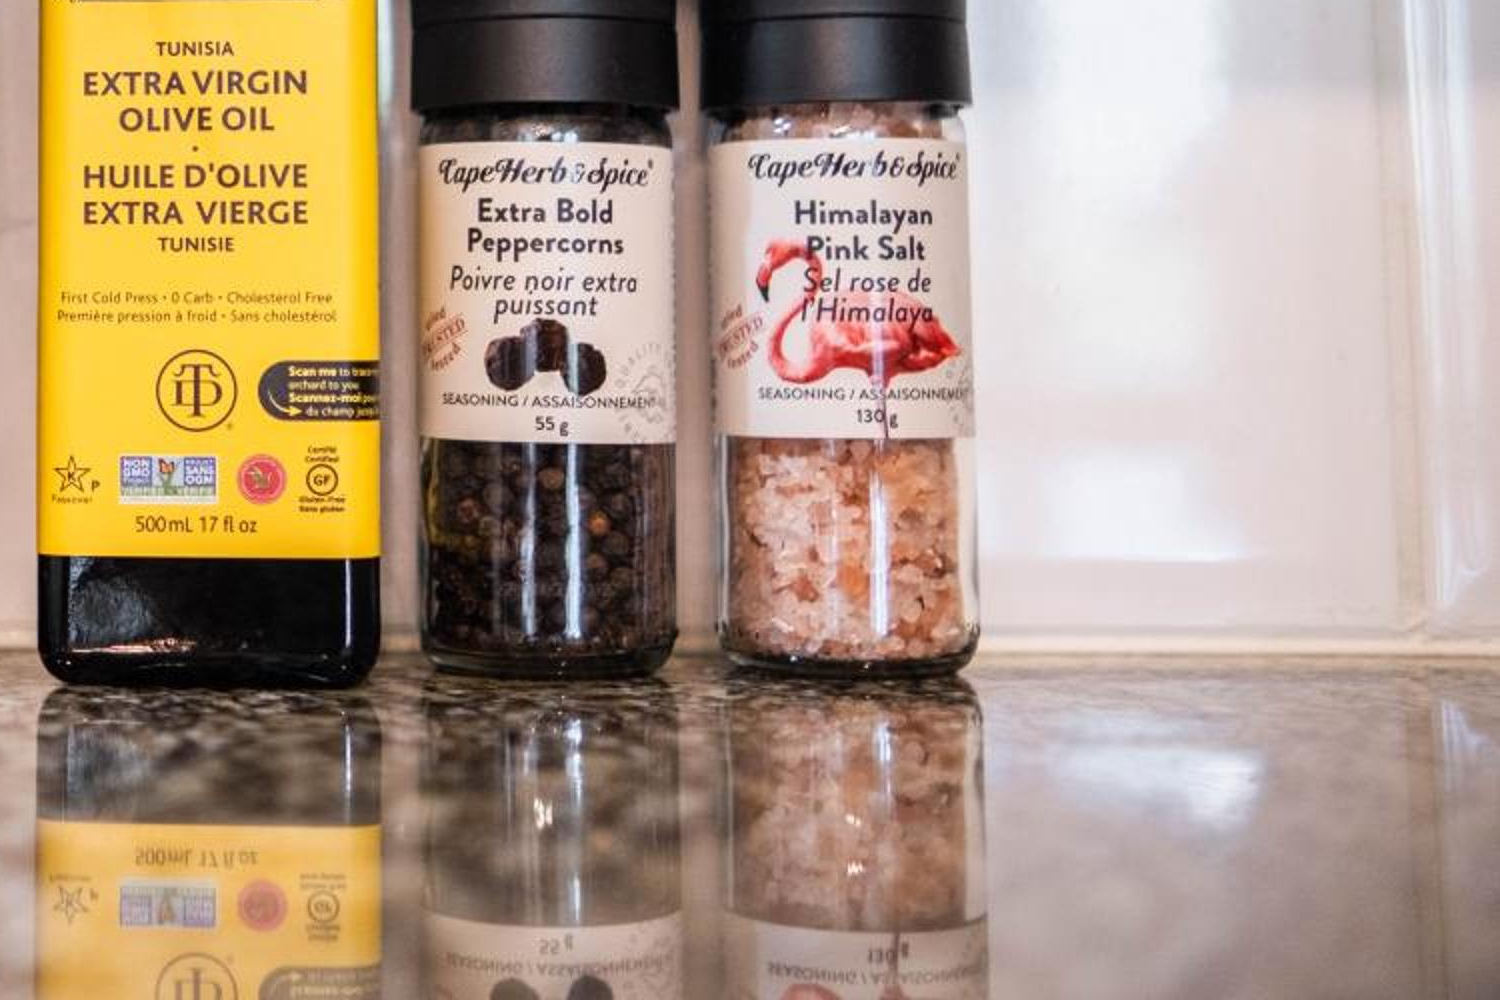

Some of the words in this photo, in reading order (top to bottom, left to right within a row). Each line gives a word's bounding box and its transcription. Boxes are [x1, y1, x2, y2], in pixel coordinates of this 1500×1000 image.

[156, 41, 235, 56] TUNISIA
[83, 71, 186, 96] EXTRA
[192, 70, 308, 95] VIRGIN
[119, 107, 213, 132] OLIVE
[221, 106, 275, 131] OIL
[83, 165, 175, 189] HUILE
[185, 163, 308, 188] D'OLIVE
[83, 201, 183, 225] EXTRA
[196, 201, 309, 225] VIERGE
[477, 198, 546, 223] Extra
[556, 198, 613, 224] Bold
[793, 200, 934, 233] Himalayan
[157, 237, 235, 252] TUNISIE
[467, 228, 624, 262] Peppercorns
[805, 236, 869, 261] Pink
[877, 236, 926, 261] Salt
[450, 265, 515, 291] Poivre
[525, 267, 574, 292] noir
[582, 272, 637, 293] extra
[803, 267, 840, 292] Sel
[850, 275, 899, 293] rose
[907, 268, 931, 293] de
[61, 291, 88, 304] First
[92, 291, 121, 304] Cold
[125, 291, 159, 304] Press
[183, 291, 213, 304] Carb
[227, 291, 301, 305] Cholesterol
[305, 291, 333, 304] Free
[493, 290, 599, 324] puissant
[57, 309, 115, 322] Première
[118, 309, 171, 324] pression
[187, 308, 217, 322] froid
[230, 309, 260, 323] Sans
[263, 308, 337, 323] cholestérol
[801, 298, 934, 333] l'Himalaya
[288, 365, 317, 377] Scan
[442, 392, 519, 407] SEASONING
[758, 386, 846, 401] SEASONING
[534, 416, 555, 431] 55
[559, 420, 569, 436] g
[856, 409, 885, 423] 130
[889, 414, 899, 429] g
[91, 480, 100, 492] P
[135, 516, 194, 533] 500mL
[199, 516, 218, 533] 17
[222, 515, 234, 533] fl
[239, 520, 258, 533] oz
